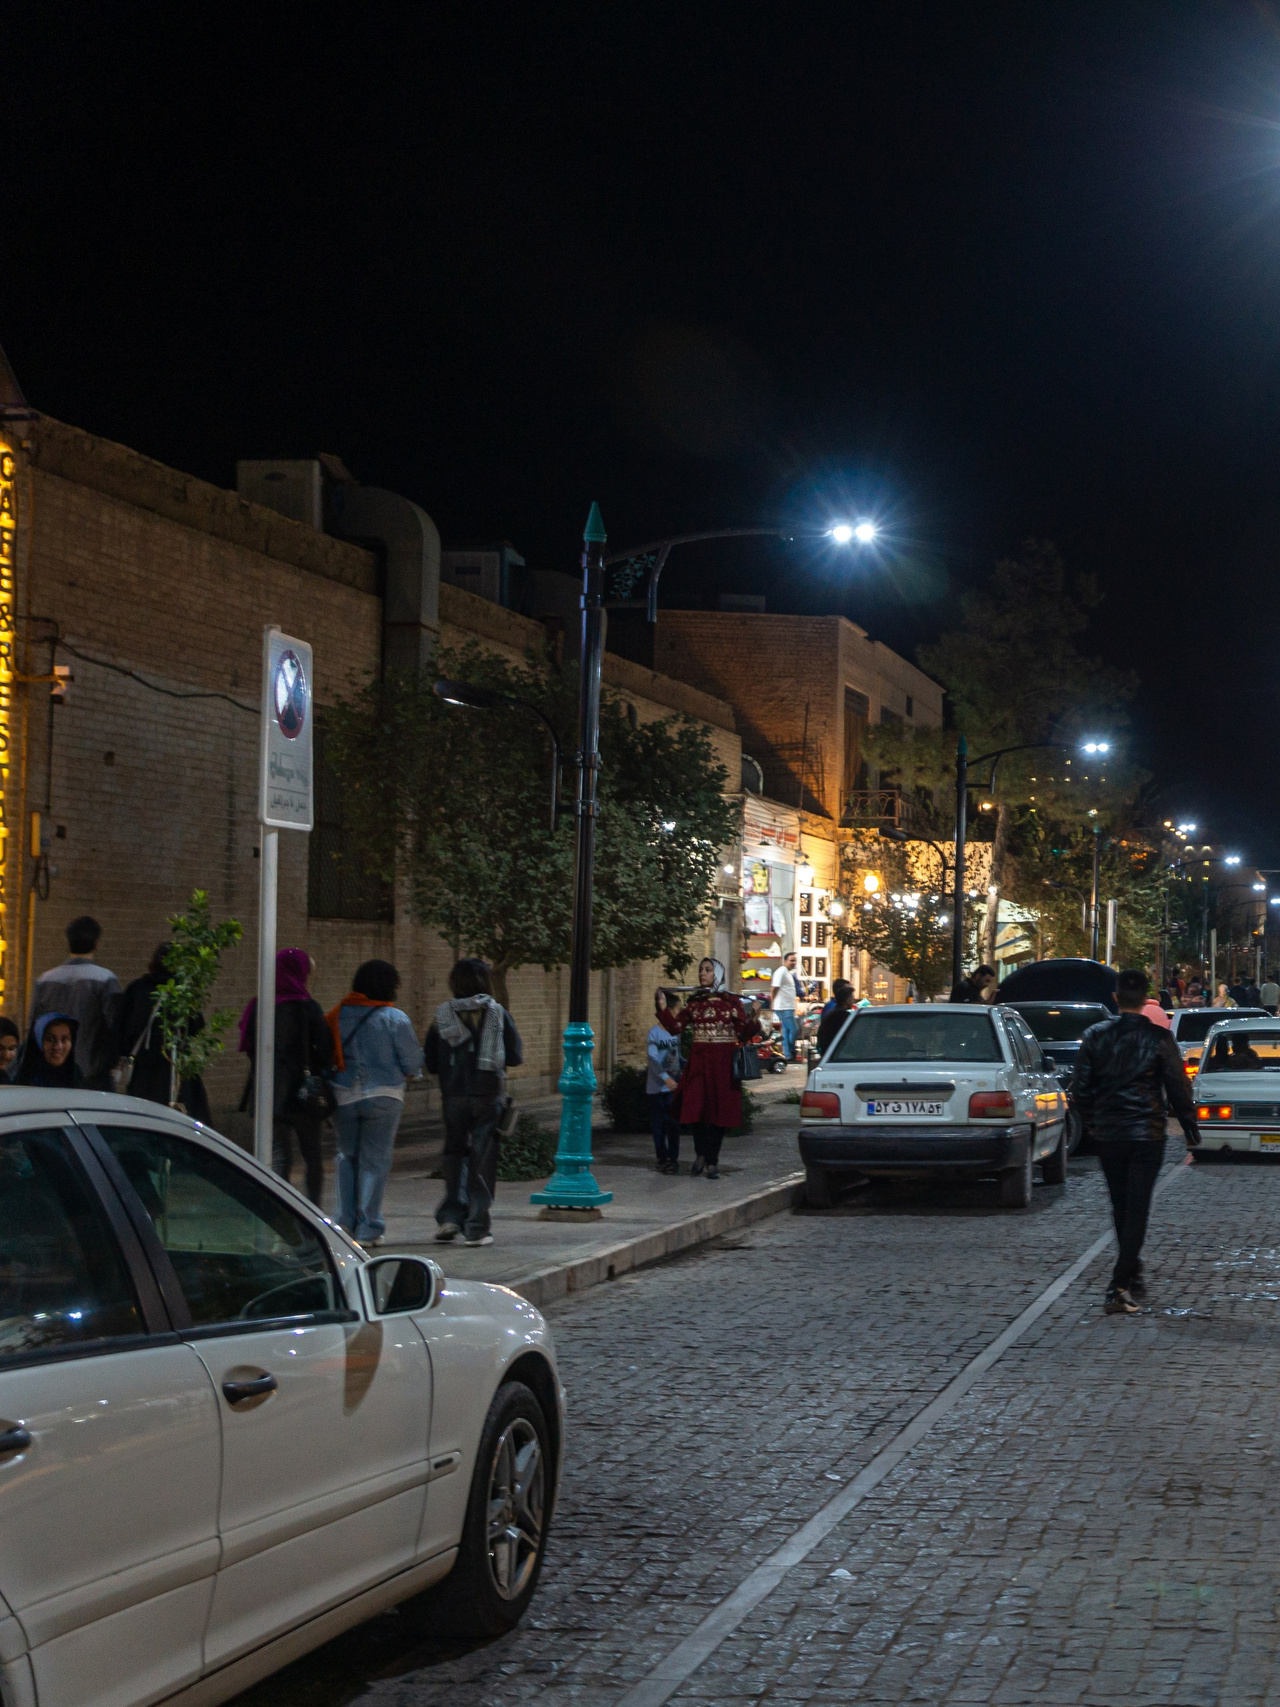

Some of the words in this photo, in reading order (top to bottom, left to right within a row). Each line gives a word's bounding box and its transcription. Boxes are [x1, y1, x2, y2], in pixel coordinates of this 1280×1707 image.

[892, 1101, 902, 1113] ق
[905, 1101, 926, 1113] ۱۷۸
[928, 1103, 941, 1113] ۵۴
